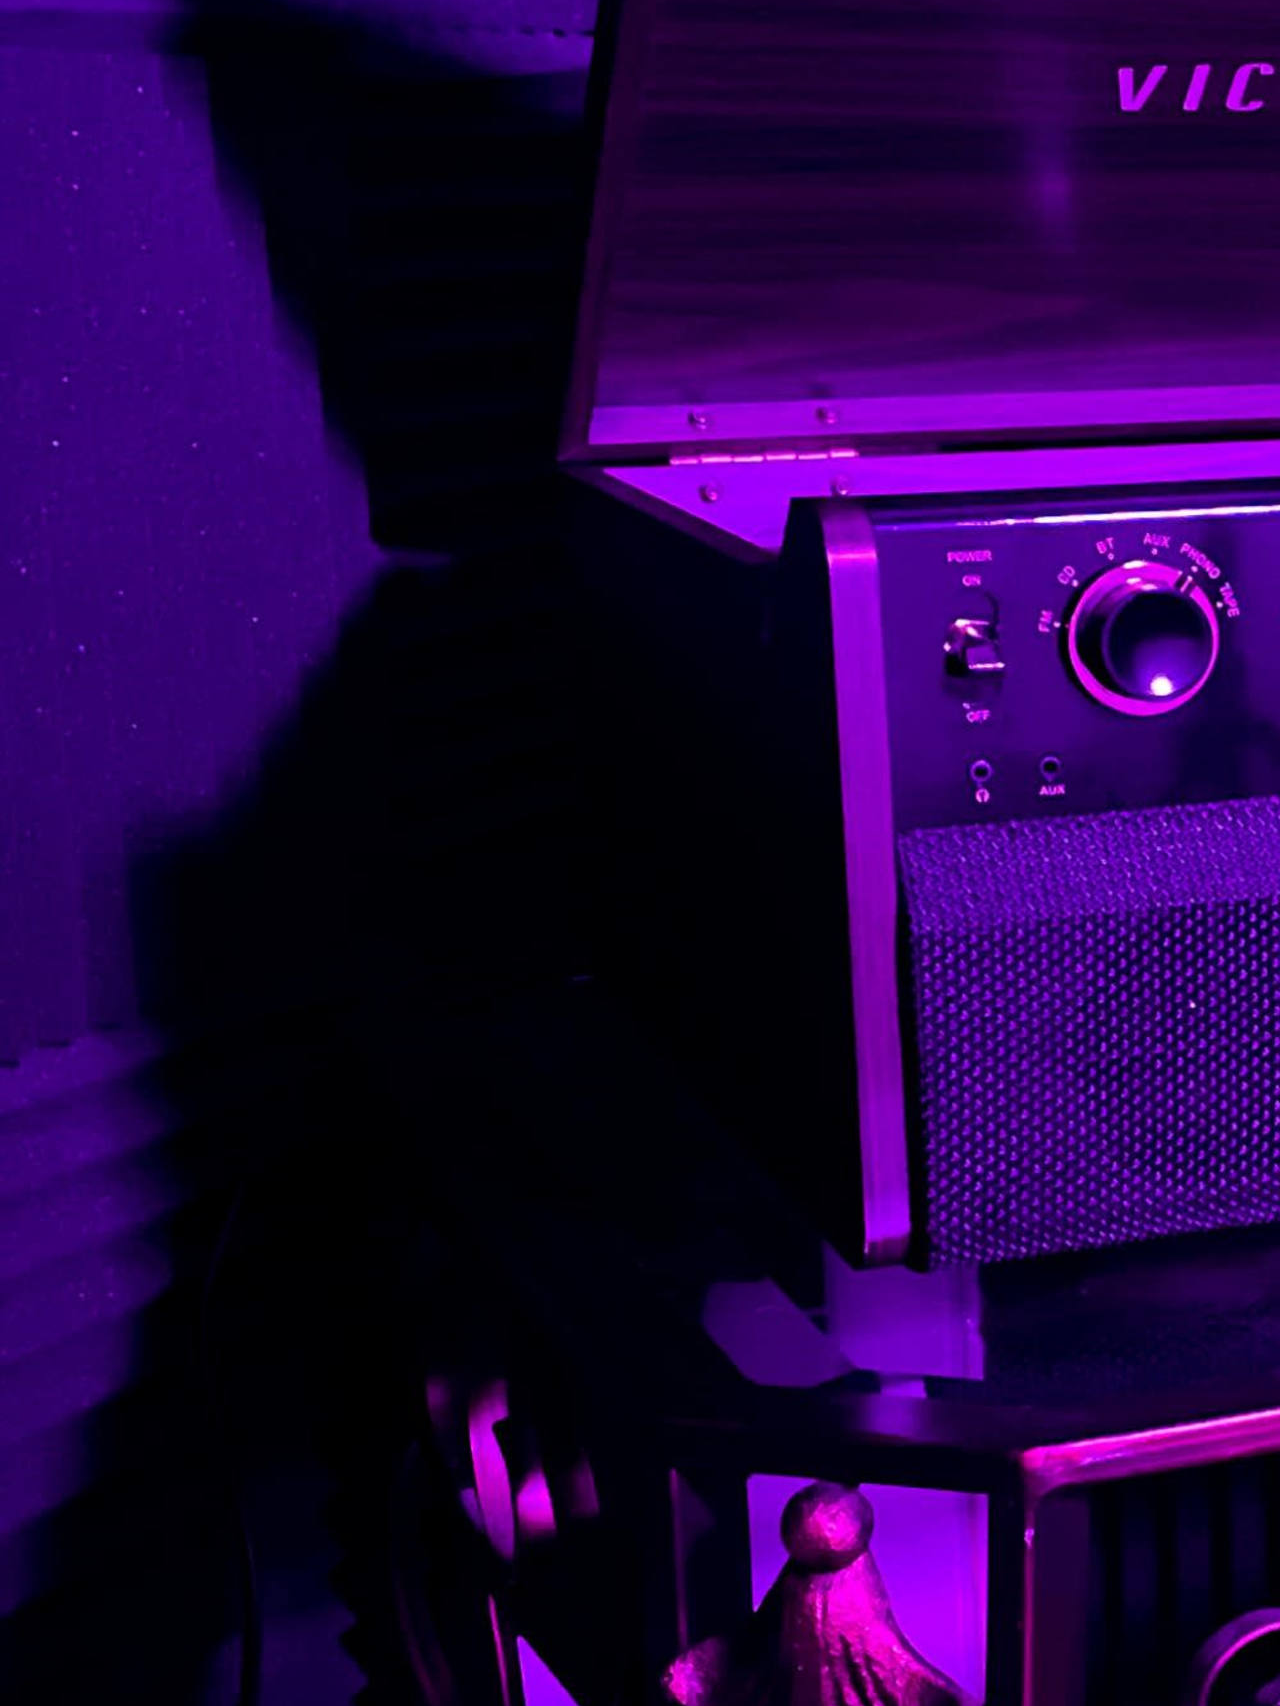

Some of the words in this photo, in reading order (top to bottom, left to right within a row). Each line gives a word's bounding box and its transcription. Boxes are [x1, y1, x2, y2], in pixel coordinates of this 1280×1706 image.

[1096, 536, 1115, 555] BT
[1143, 532, 1171, 549] AUX
[946, 549, 993, 564] POWER
[1179, 542, 1222, 580] PHONO
[961, 574, 982, 587] ON
[1057, 565, 1076, 585] CD
[1218, 581, 1241, 618] TAPE
[1037, 608, 1054, 633] FM
[1038, 784, 1066, 796] AUX
